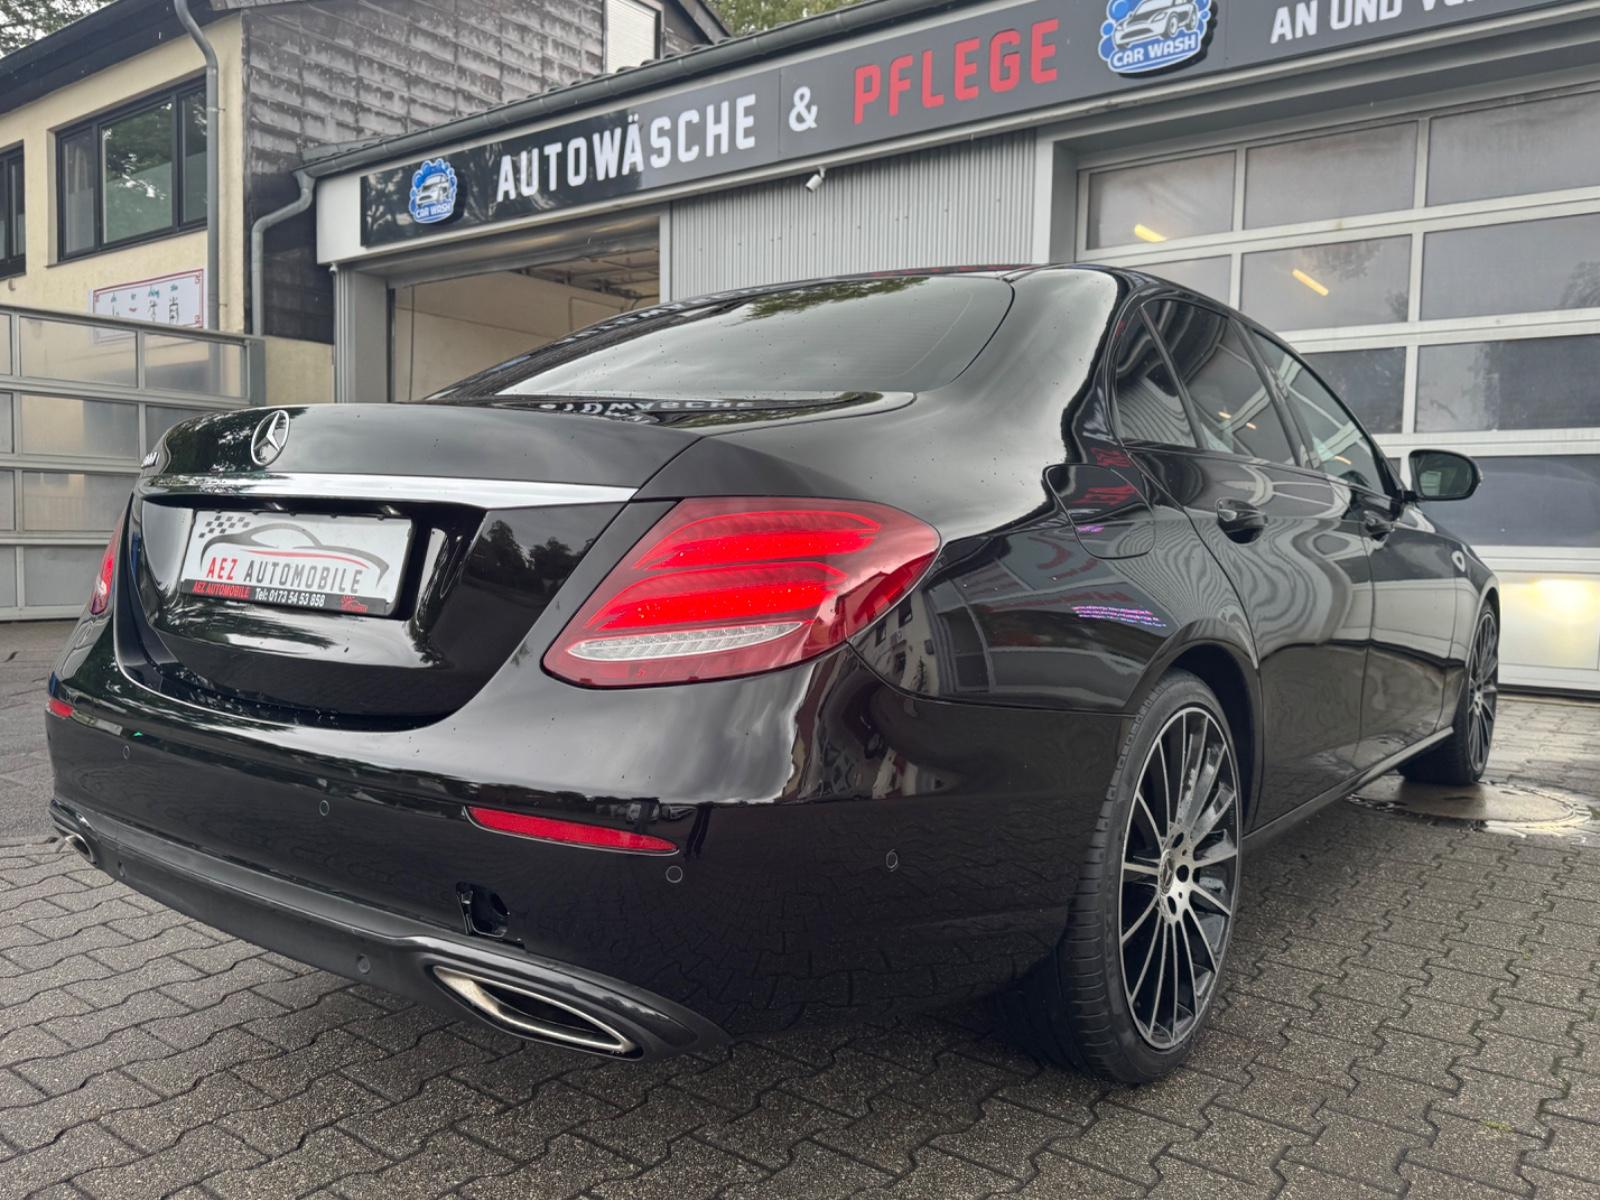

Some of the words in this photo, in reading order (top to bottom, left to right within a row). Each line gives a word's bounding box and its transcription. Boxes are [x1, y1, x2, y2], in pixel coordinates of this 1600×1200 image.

[1270, 1, 1318, 44] AN
[1330, 0, 1402, 30] UND
[1113, 47, 1145, 67] CAR
[1147, 34, 1197, 59] WASH
[496, 93, 756, 202] AUTOWÄSCHE
[788, 86, 819, 131] &
[853, 18, 1059, 126] PFLEGE
[206, 556, 238, 580] AEZ
[243, 559, 363, 594] AUTOMOBILE
[207, 582, 250, 599] AUTOMOBILE
[268, 589, 288, 604] 0173
